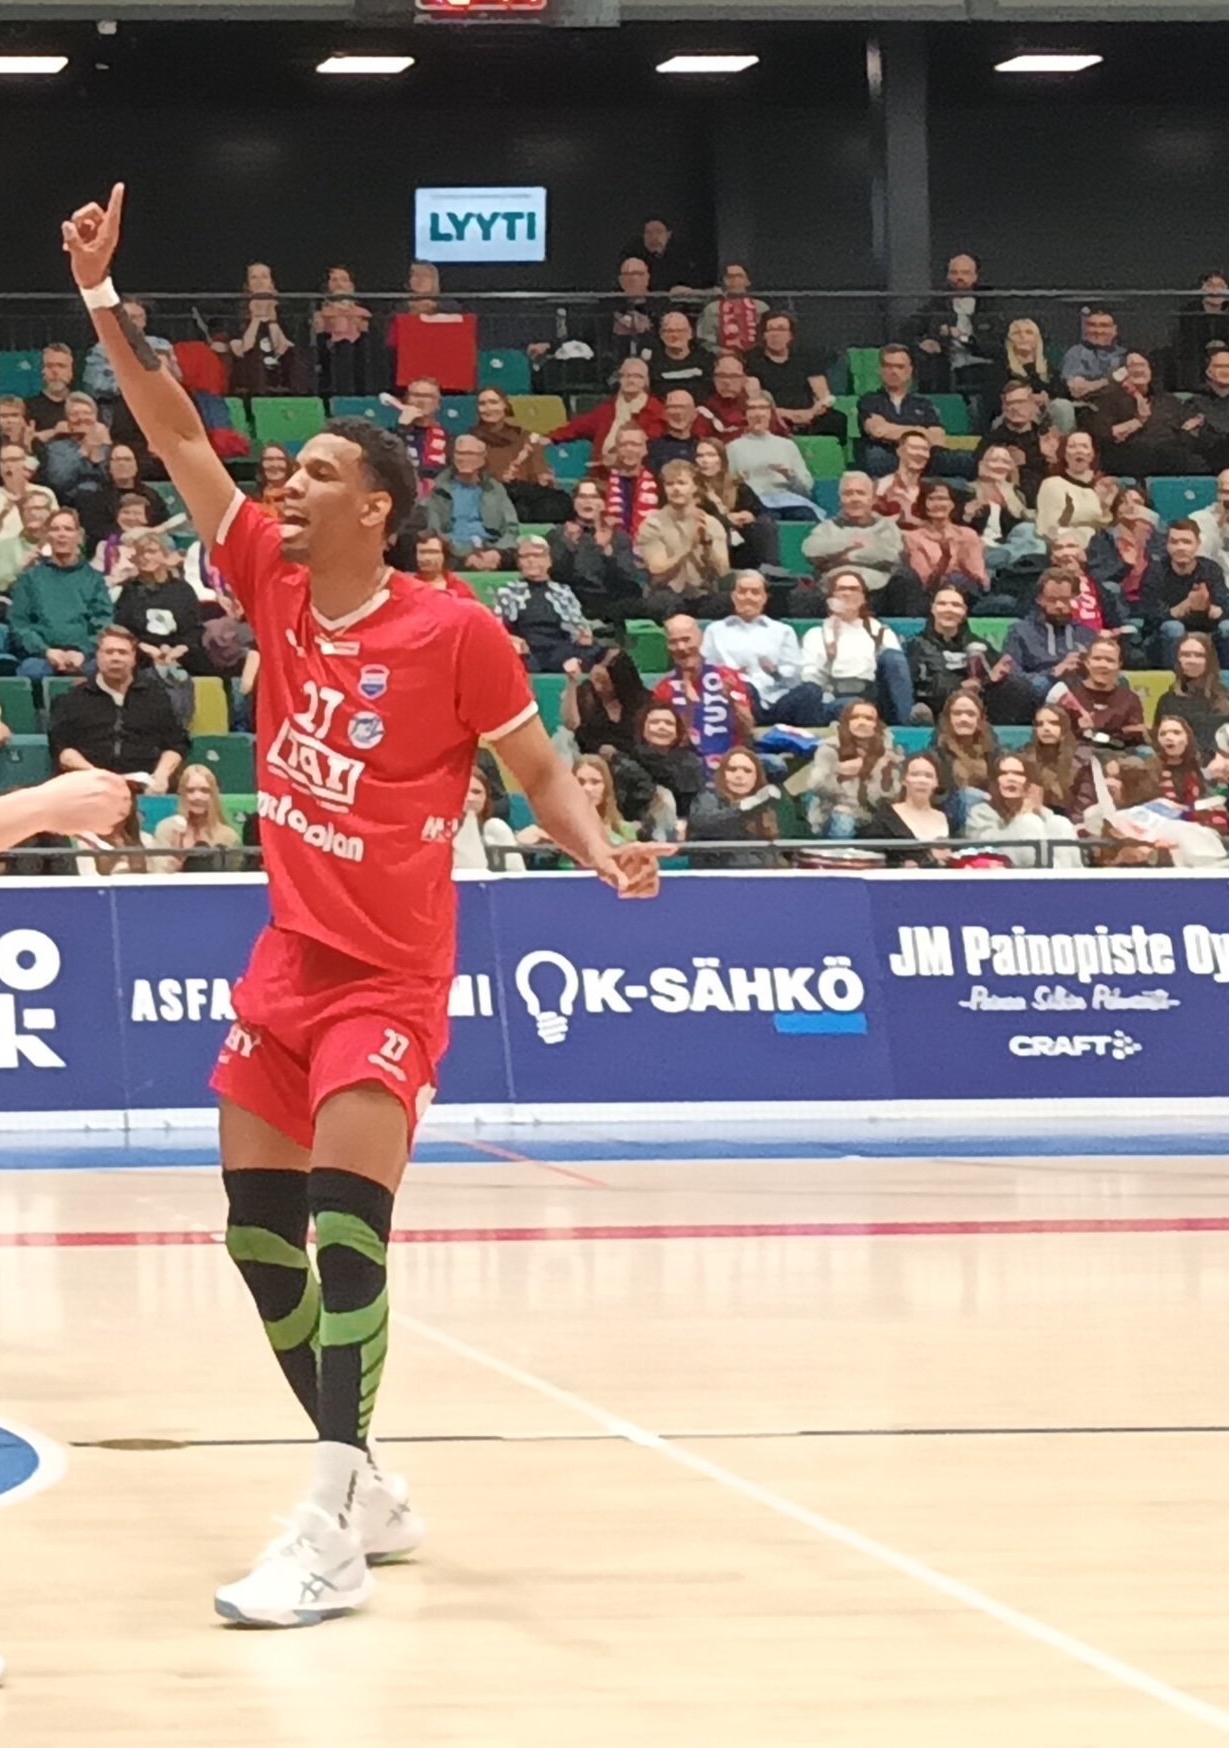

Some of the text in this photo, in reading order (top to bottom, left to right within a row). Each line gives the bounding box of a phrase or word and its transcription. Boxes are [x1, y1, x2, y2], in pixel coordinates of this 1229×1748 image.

[429, 211, 537, 242] LYYTI
[889, 926, 955, 977] JM
[961, 925, 1176, 984] Painopiste
[131, 977, 243, 1021] ASFA
[582, 956, 865, 1013] K-SÄHKÖ
[1009, 1035, 1114, 1057] CRAFT
